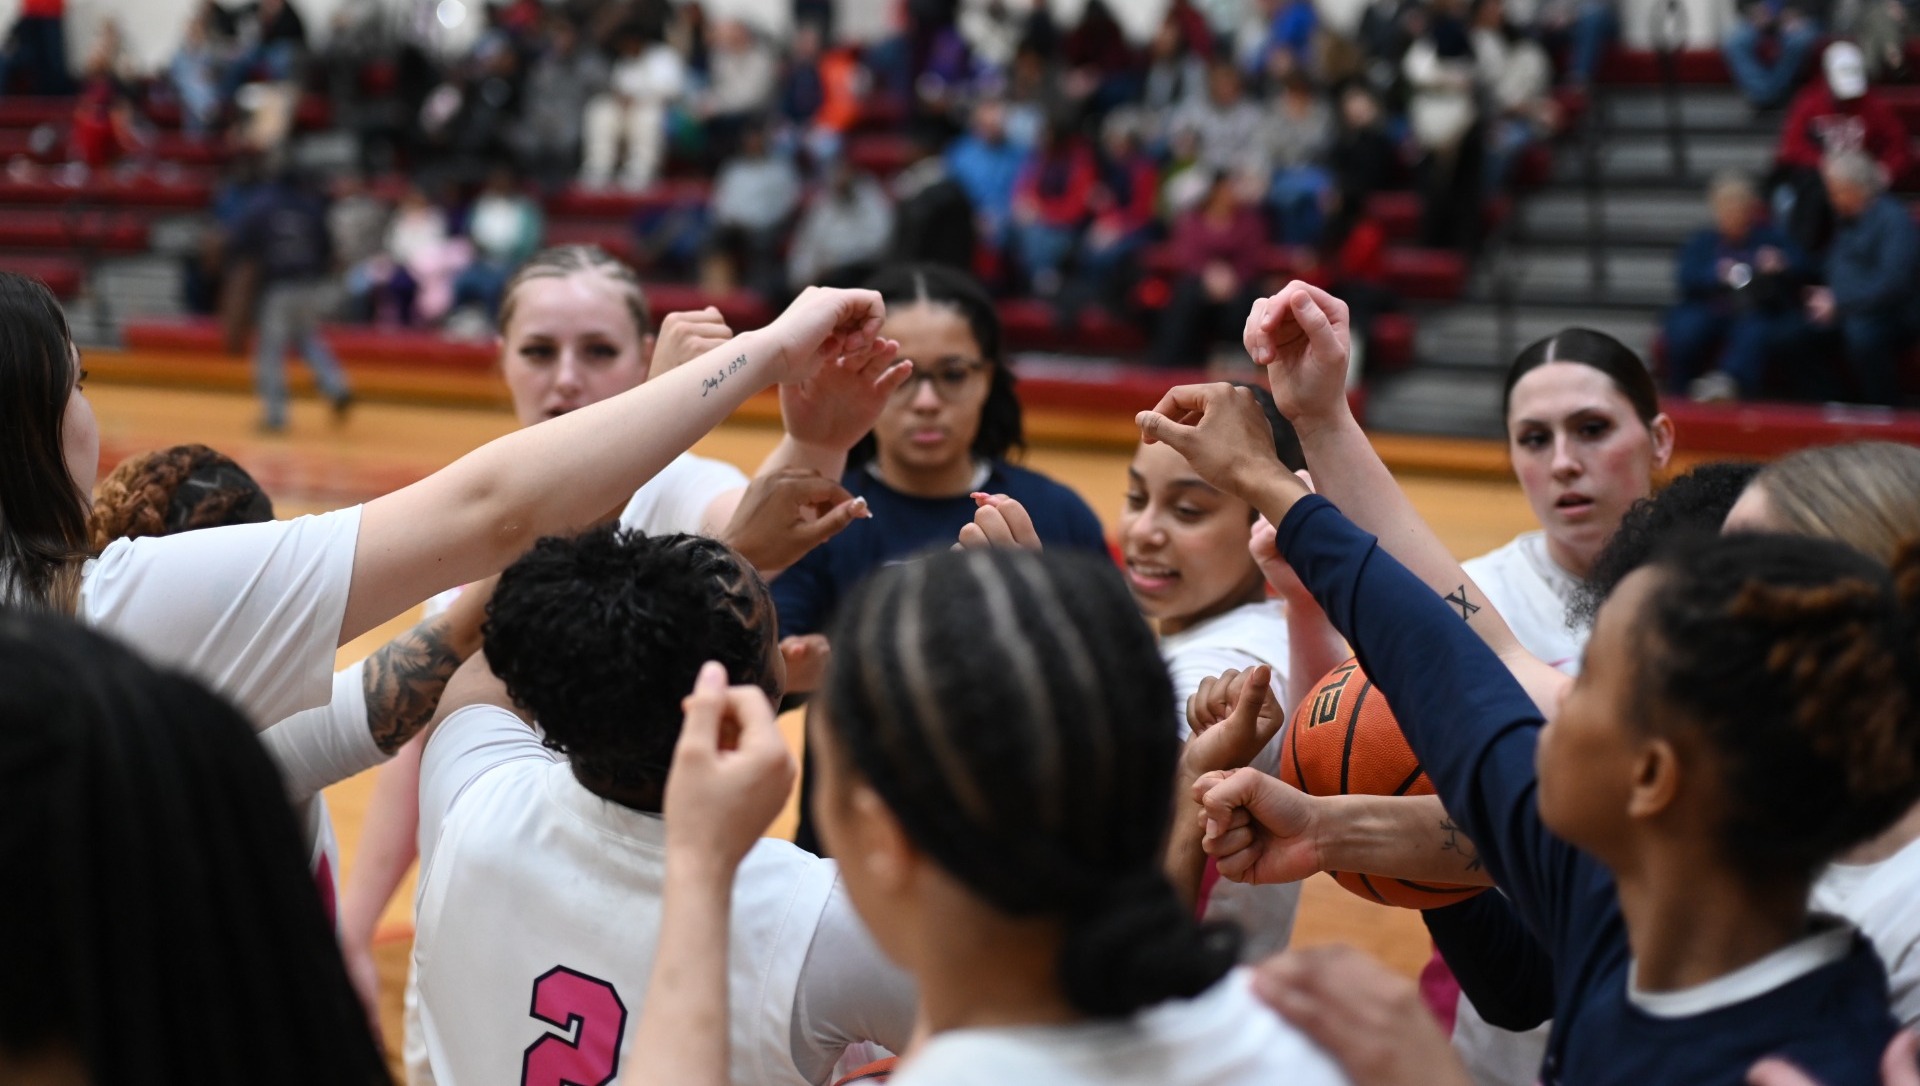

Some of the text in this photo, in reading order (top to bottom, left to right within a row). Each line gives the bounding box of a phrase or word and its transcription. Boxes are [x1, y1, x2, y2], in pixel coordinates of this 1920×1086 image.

[702, 377, 718, 397] July
[1444, 584, 1481, 622] X
[520, 964, 628, 1086] 2
